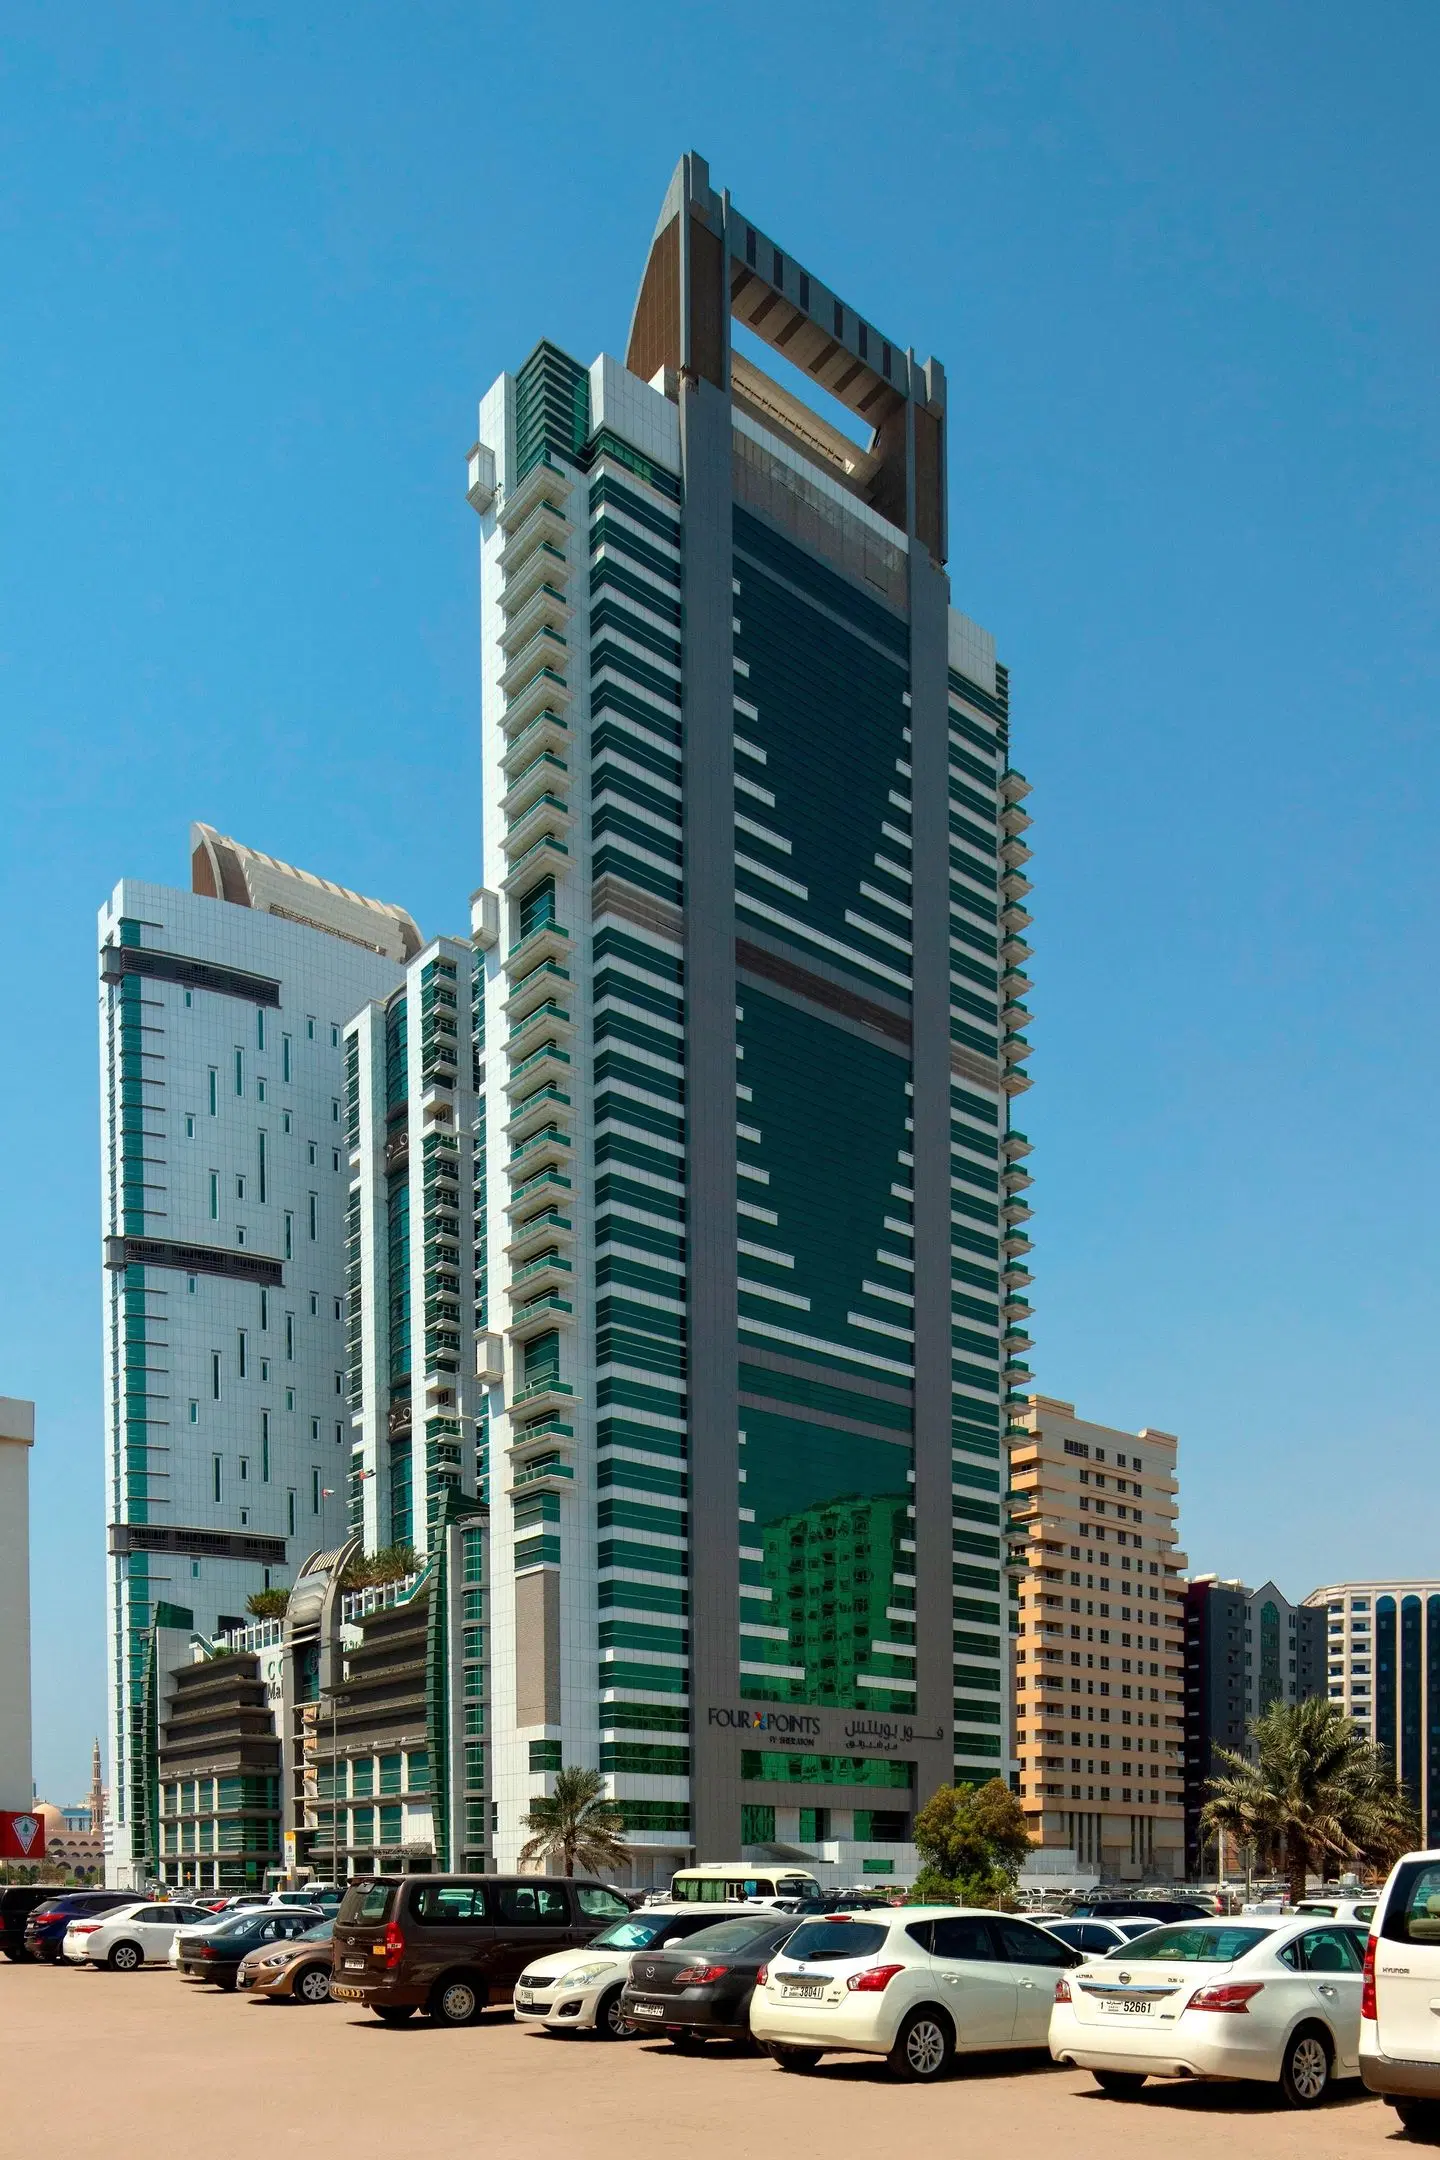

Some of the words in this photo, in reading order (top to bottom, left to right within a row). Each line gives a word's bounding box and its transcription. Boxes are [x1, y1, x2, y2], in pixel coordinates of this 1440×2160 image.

[707, 1707, 751, 1729] FOUR
[767, 1712, 820, 1736] POINTS
[783, 1986, 788, 1996] P
[799, 1985, 822, 1997] 38041
[1123, 2000, 1152, 2014] 52661
